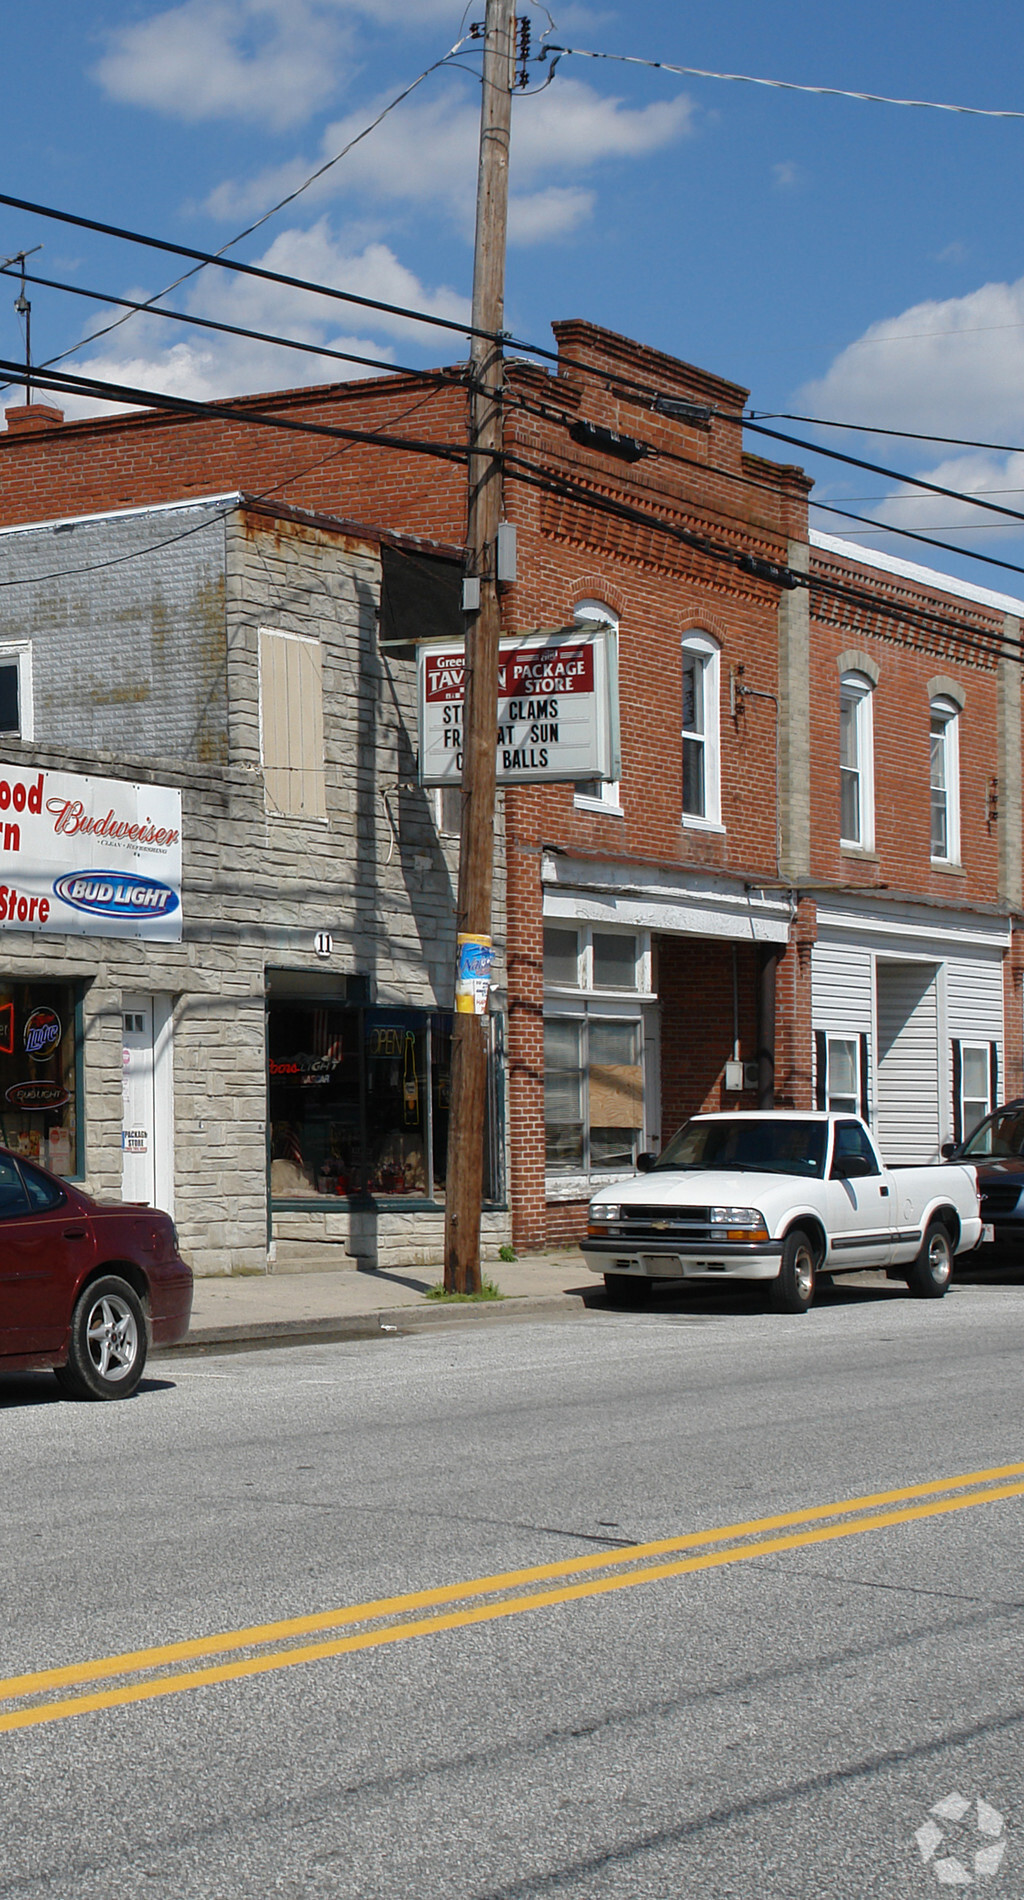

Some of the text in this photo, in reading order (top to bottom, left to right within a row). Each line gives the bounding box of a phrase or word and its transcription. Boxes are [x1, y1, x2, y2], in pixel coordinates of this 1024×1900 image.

[428, 666, 507, 692] TAVN
[513, 660, 586, 680] PACKAGE
[524, 677, 575, 694] STORE
[509, 699, 559, 722] CLAMS
[444, 723, 559, 748] FR AT SUN
[503, 748, 549, 770] BALLS
[45, 797, 180, 847] Budweiser
[71, 879, 173, 911] BUD LIGHT
[317, 933, 331, 955] 11
[371, 1028, 403, 1056] OPEN
